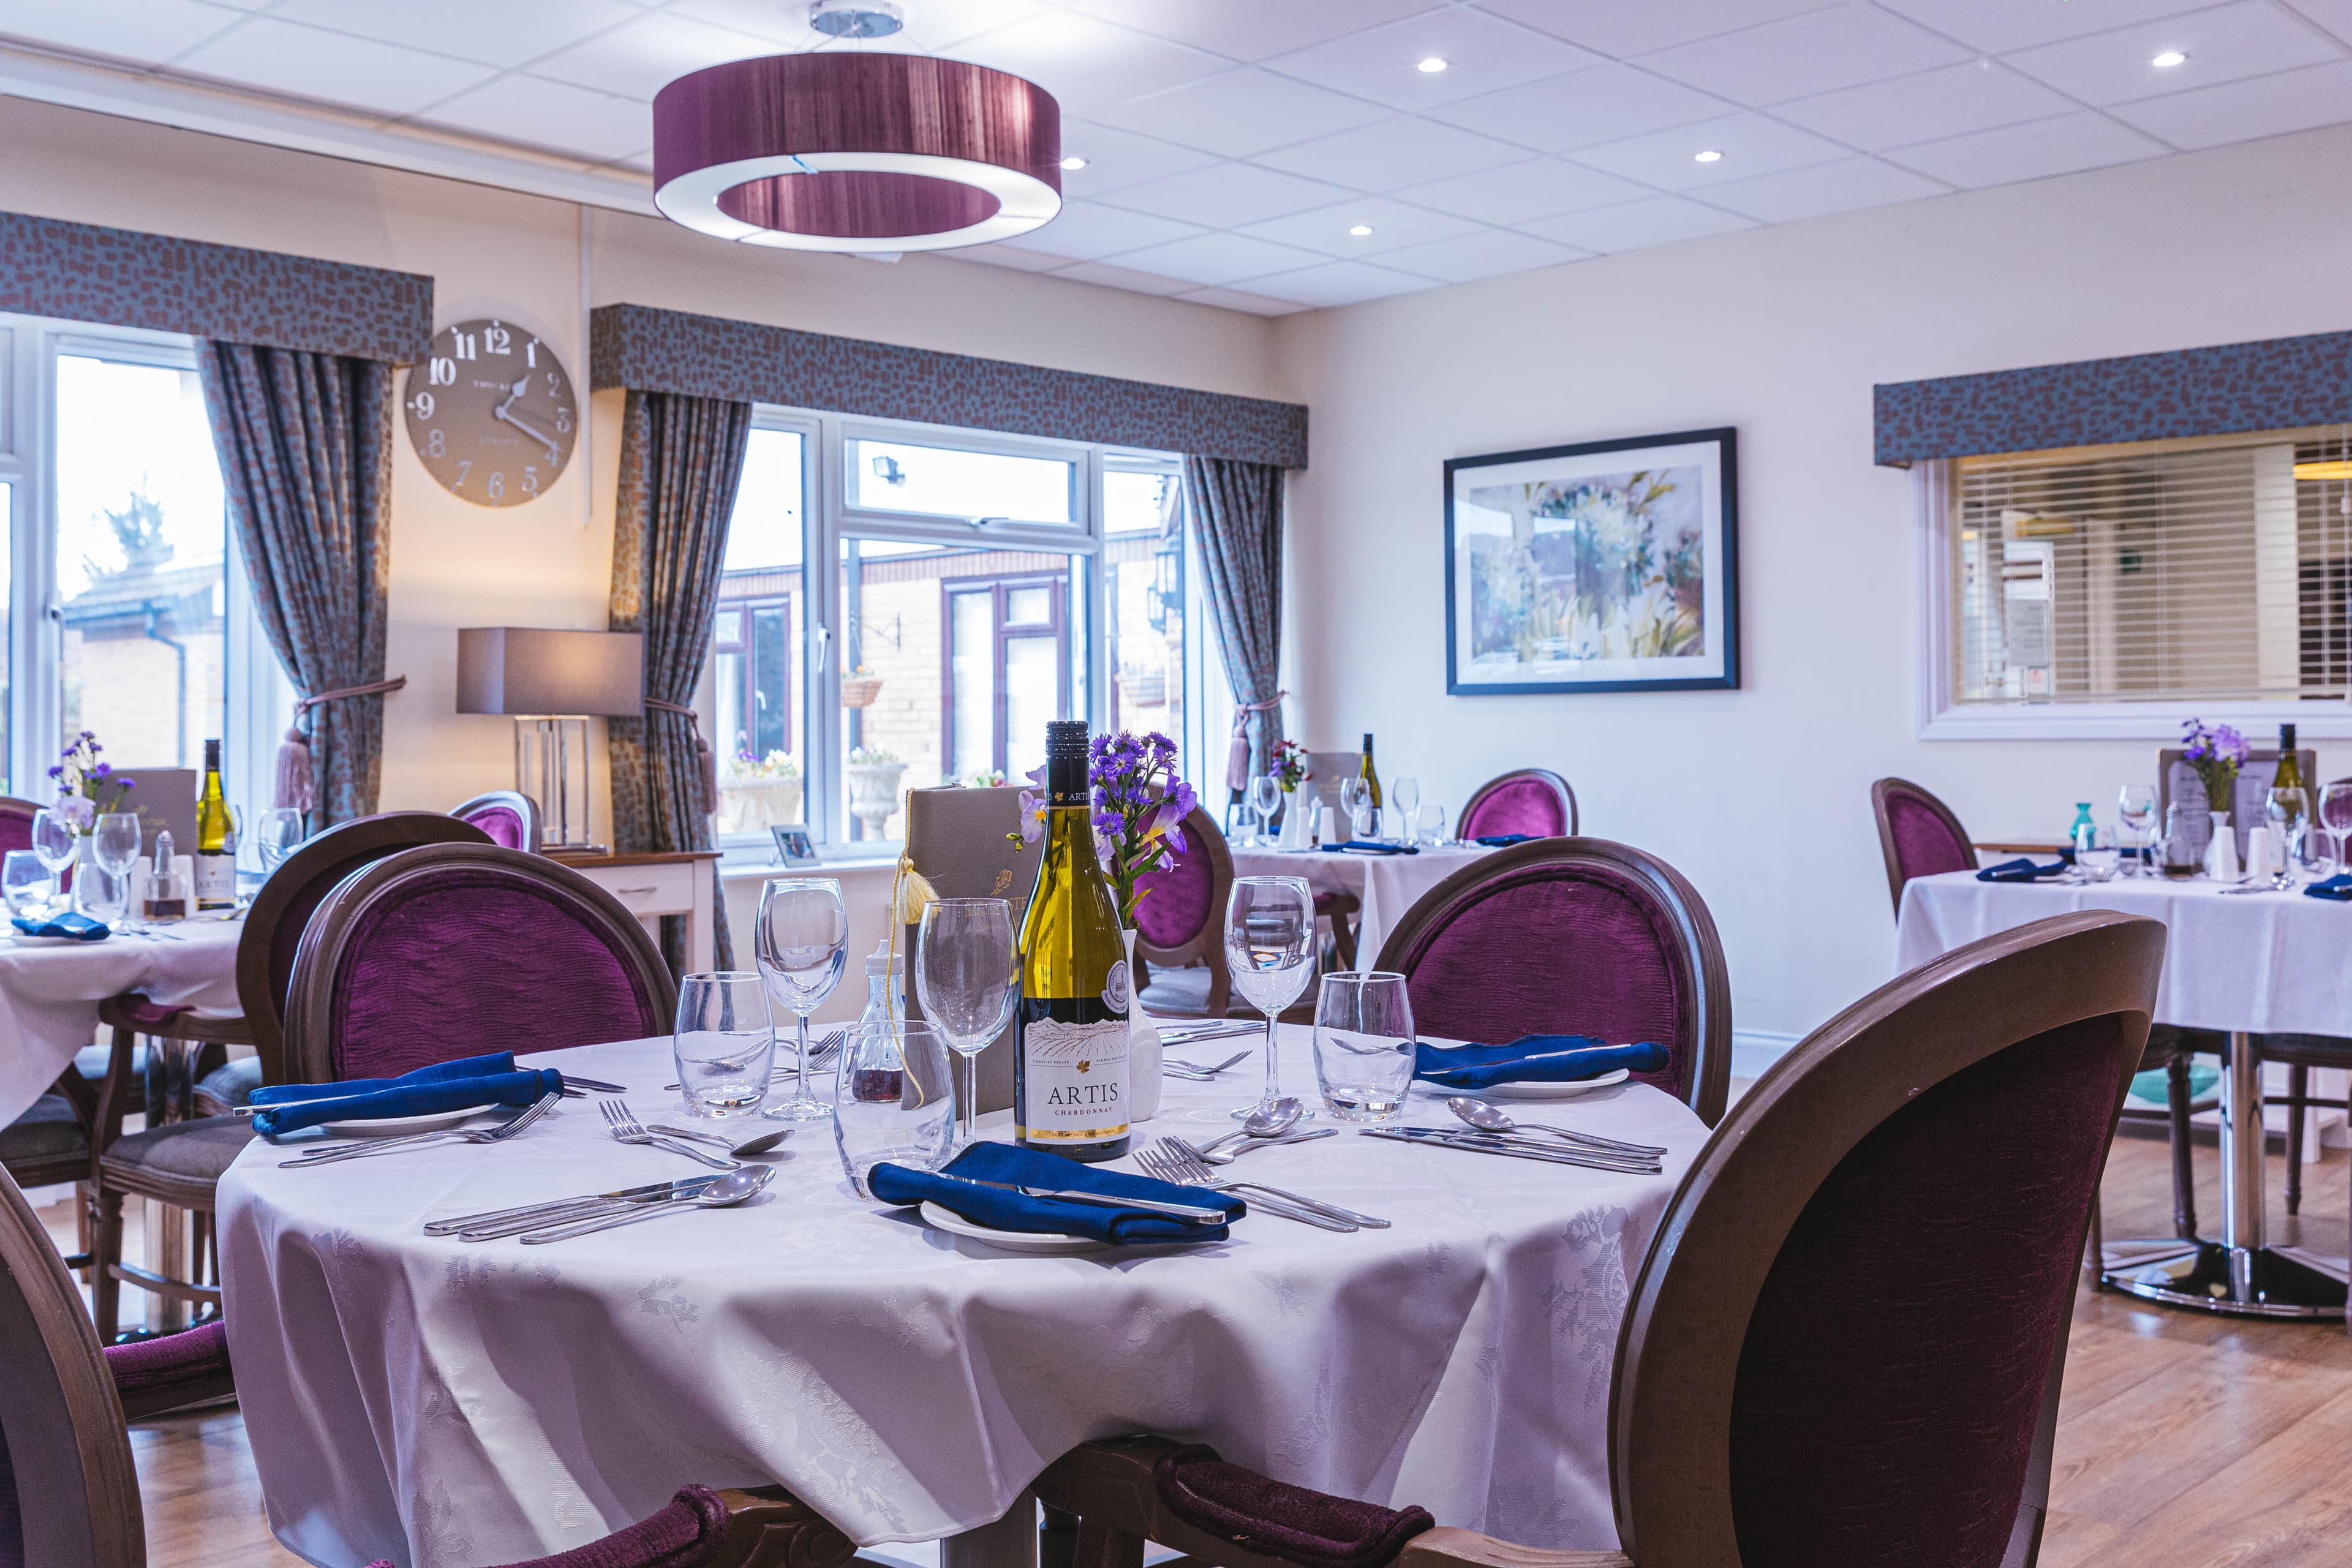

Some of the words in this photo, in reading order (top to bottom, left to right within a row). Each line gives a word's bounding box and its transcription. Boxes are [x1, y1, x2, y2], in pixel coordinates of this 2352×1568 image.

[454, 332, 477, 361] 11
[483, 326, 511, 355] 12
[526, 341, 537, 368] 1
[429, 356, 457, 386] 10
[547, 372, 561, 397] 2
[415, 391, 435, 420] 9
[429, 428, 447, 458] 8
[455, 459, 473, 487] 7
[488, 471, 505, 499] 6
[521, 466, 538, 492] 5
[1047, 1082, 1118, 1105] ARTIS
[1054, 1106, 1113, 1115] CHARDONNAY
